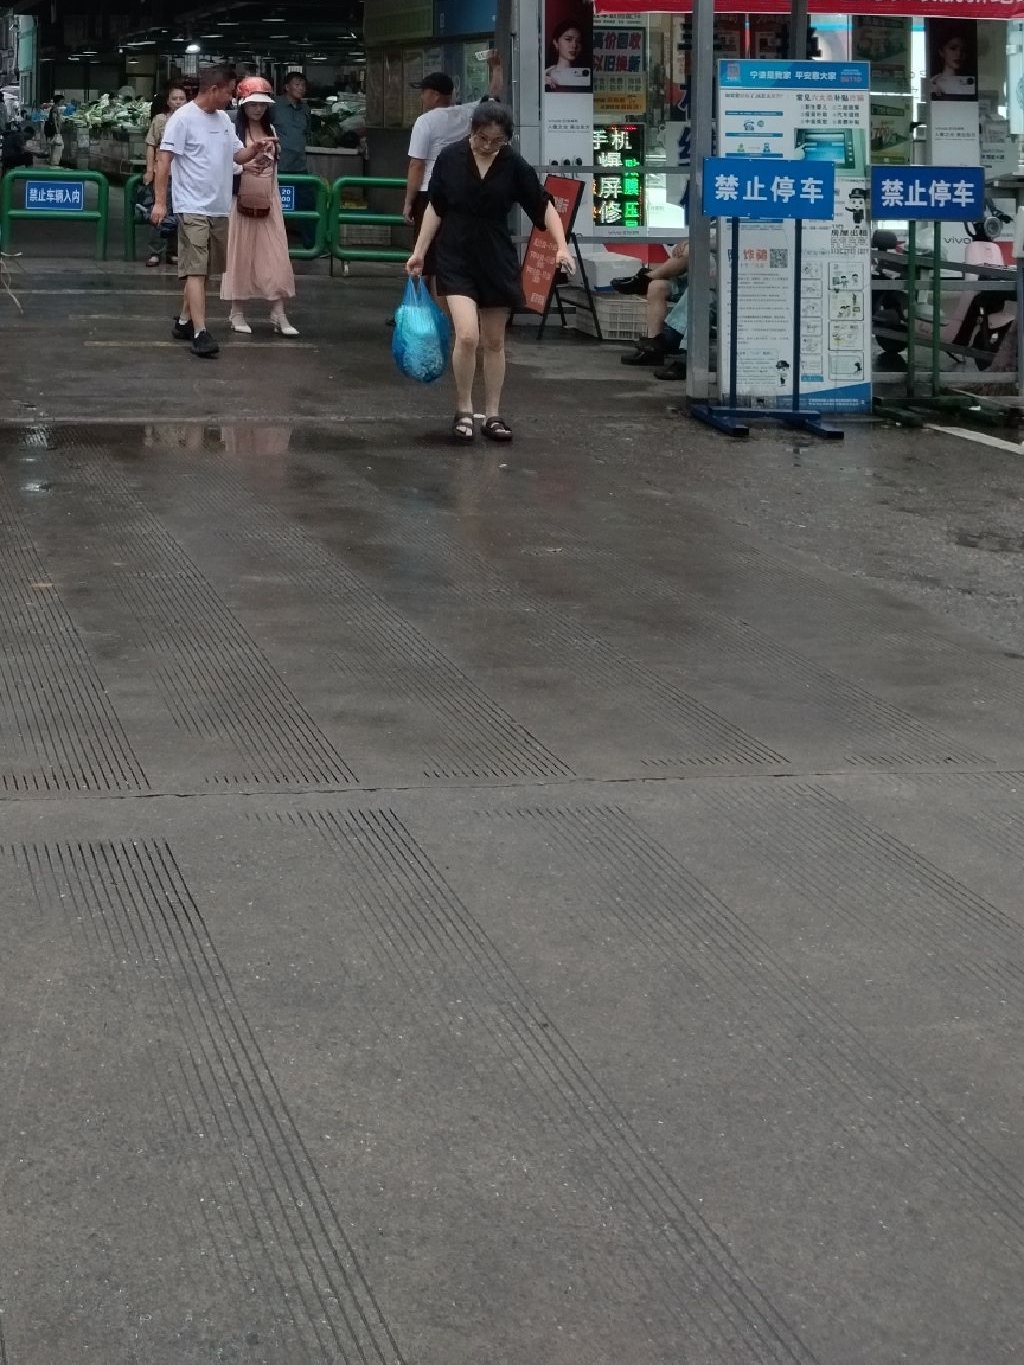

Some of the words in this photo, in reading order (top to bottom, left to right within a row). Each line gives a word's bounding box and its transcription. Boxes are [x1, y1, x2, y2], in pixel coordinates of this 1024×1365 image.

[714, 173, 825, 205] 禁止停车
[880, 178, 975, 208] 禁止停车
